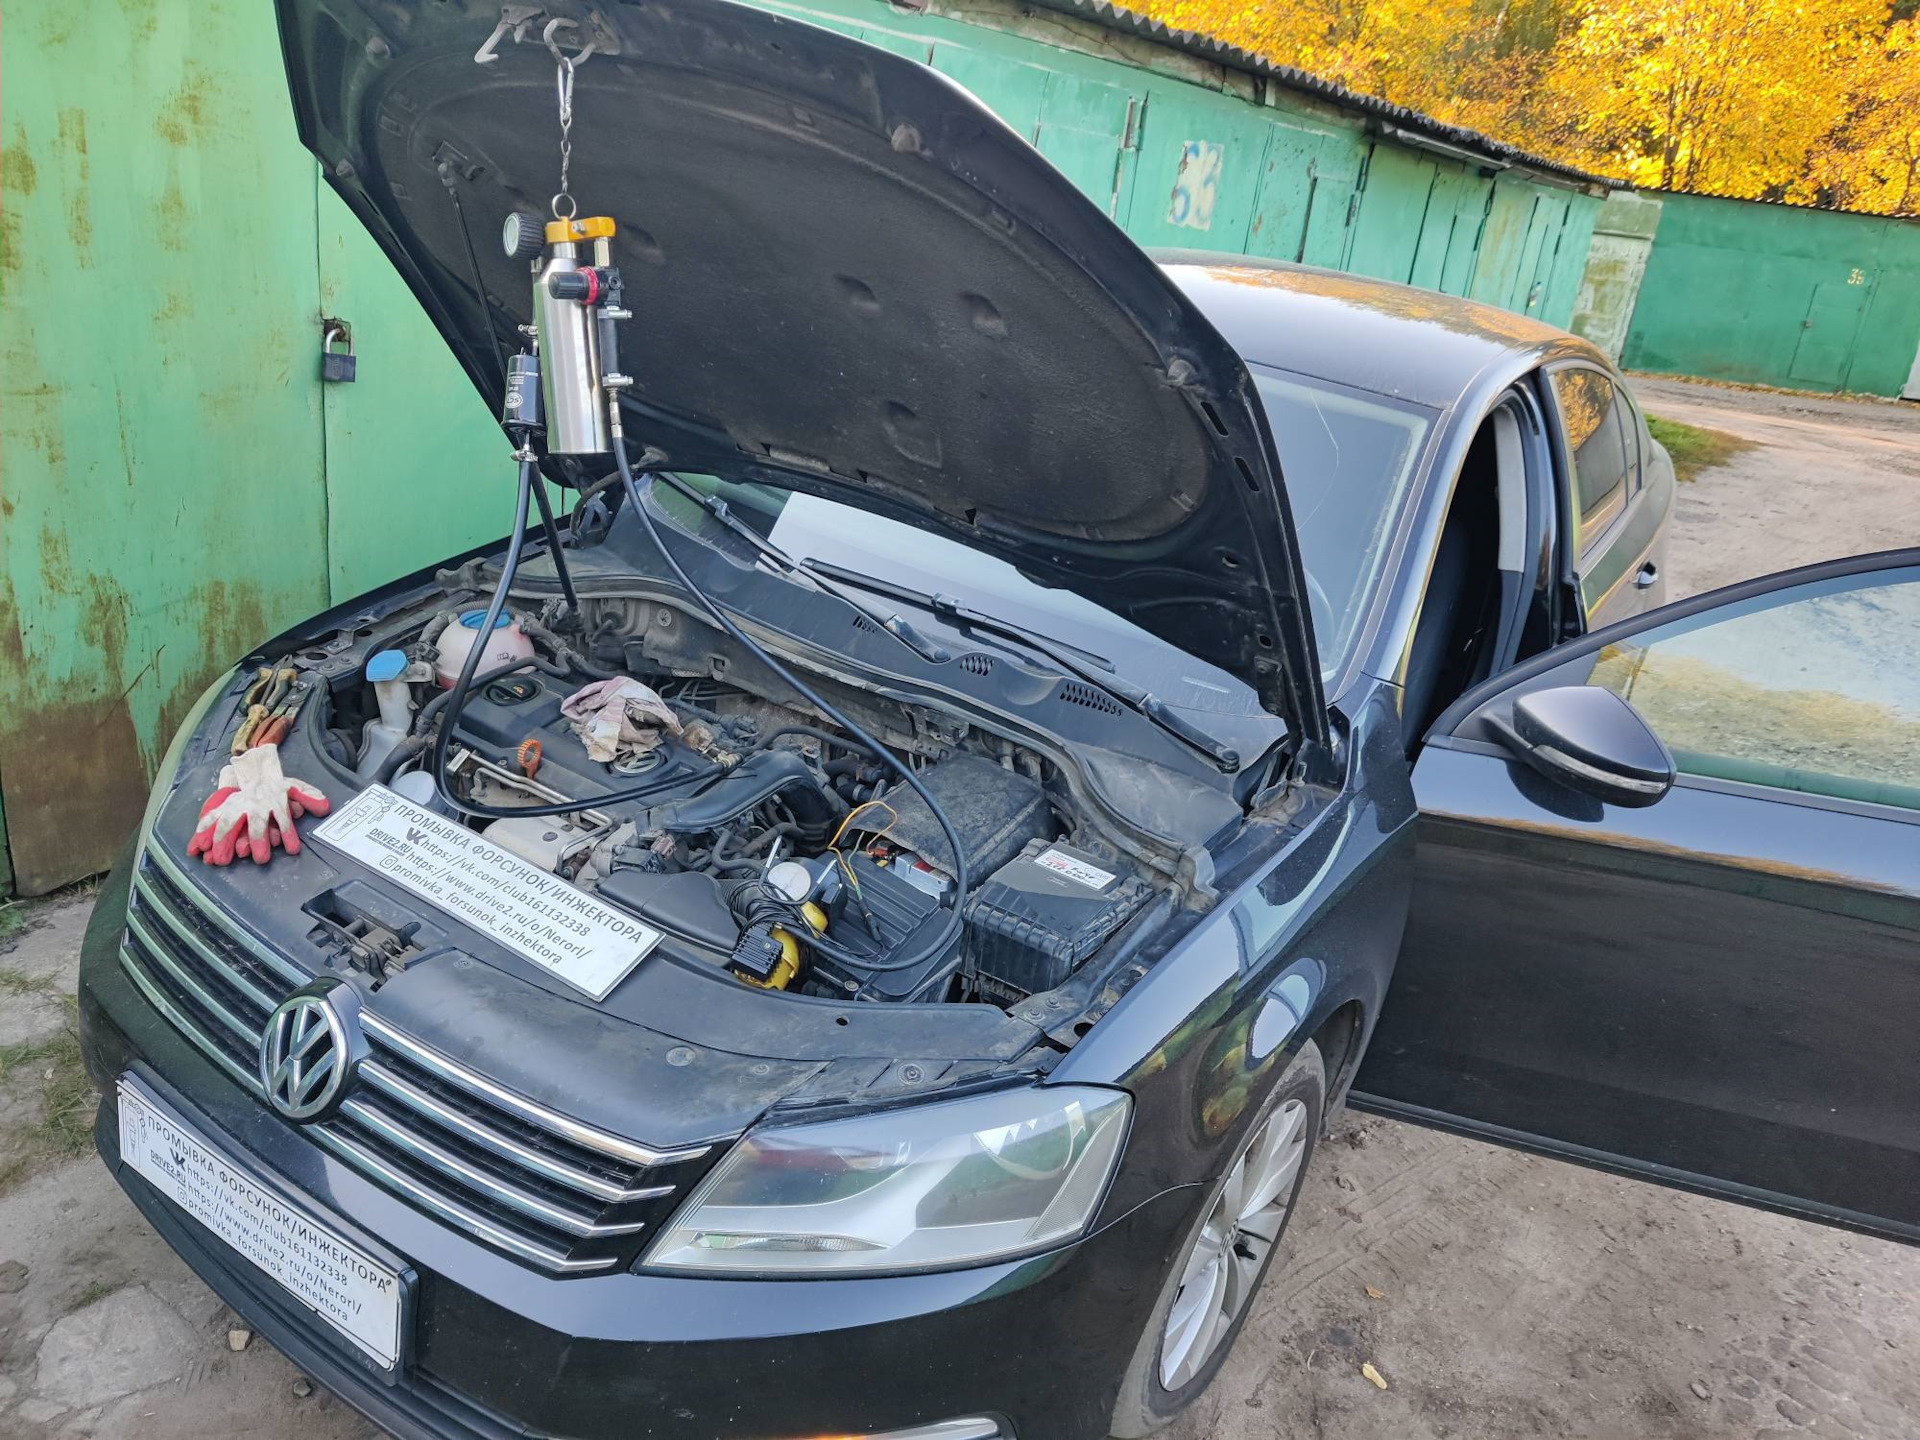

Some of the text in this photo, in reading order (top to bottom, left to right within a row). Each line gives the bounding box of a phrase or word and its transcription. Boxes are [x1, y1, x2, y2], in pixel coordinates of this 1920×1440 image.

[369, 827, 413, 854] DRIVE2.RU
[394, 804, 645, 944] ПРОМЫВКА ФОРСУНОК/ИНЖЕКТОРА
[420, 839, 591, 937] https://vk.com/club161132338
[391, 863, 563, 966] promivka_forsunok_inzhektora
[148, 1116, 388, 1294] ПРОМЫВКА ФОРСУНОК/ИНЖЕКТОРА
[150, 1149, 186, 1184] DRIVE2.RU
[187, 1167, 348, 1287] https://vk.com/club161132338
[188, 1198, 349, 1322] promivka_forsunok_inzhektora
